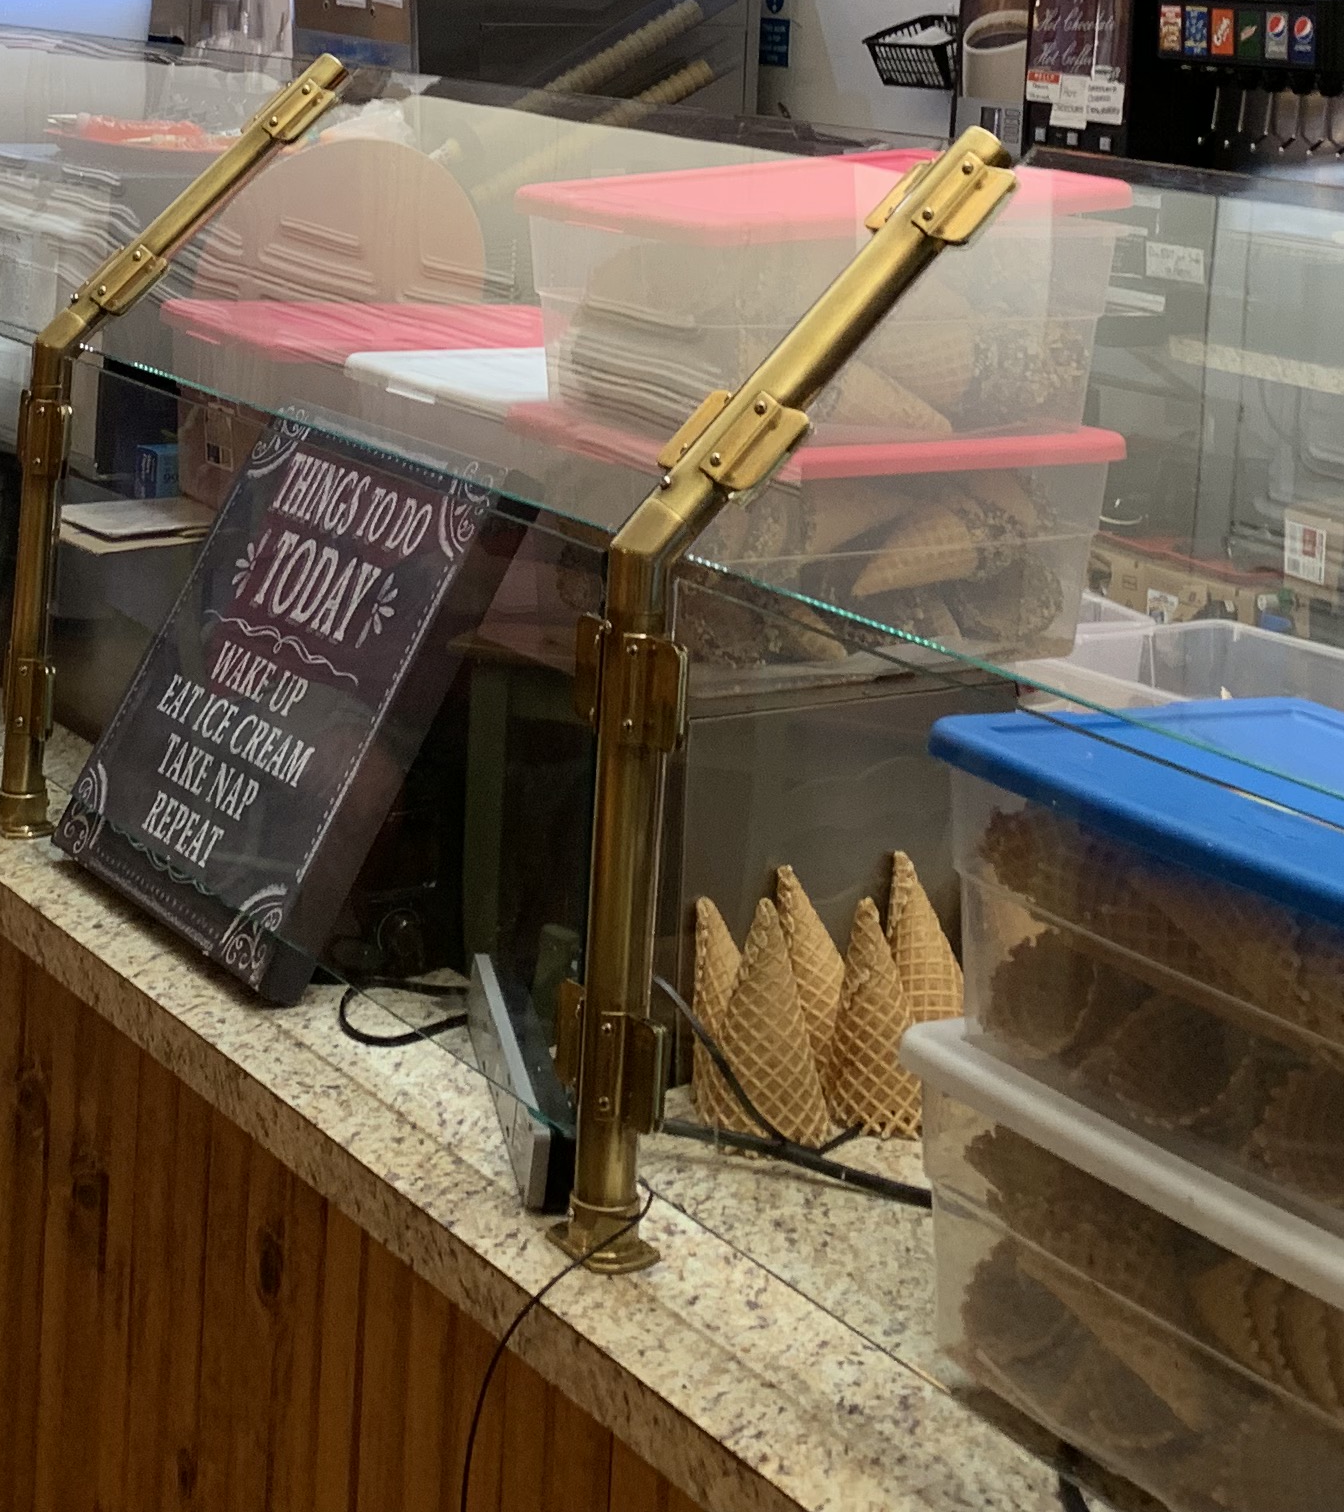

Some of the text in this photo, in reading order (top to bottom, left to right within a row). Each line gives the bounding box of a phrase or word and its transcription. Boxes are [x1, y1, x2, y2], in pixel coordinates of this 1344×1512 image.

[271, 452, 434, 556] THINGS TO DO
[254, 532, 384, 643] TODAY
[211, 640, 310, 718] WAKE UP
[156, 674, 316, 789] EAT ICE CREAM
[158, 732, 259, 822] TAKE NAP
[141, 790, 224, 869] REPEAT
